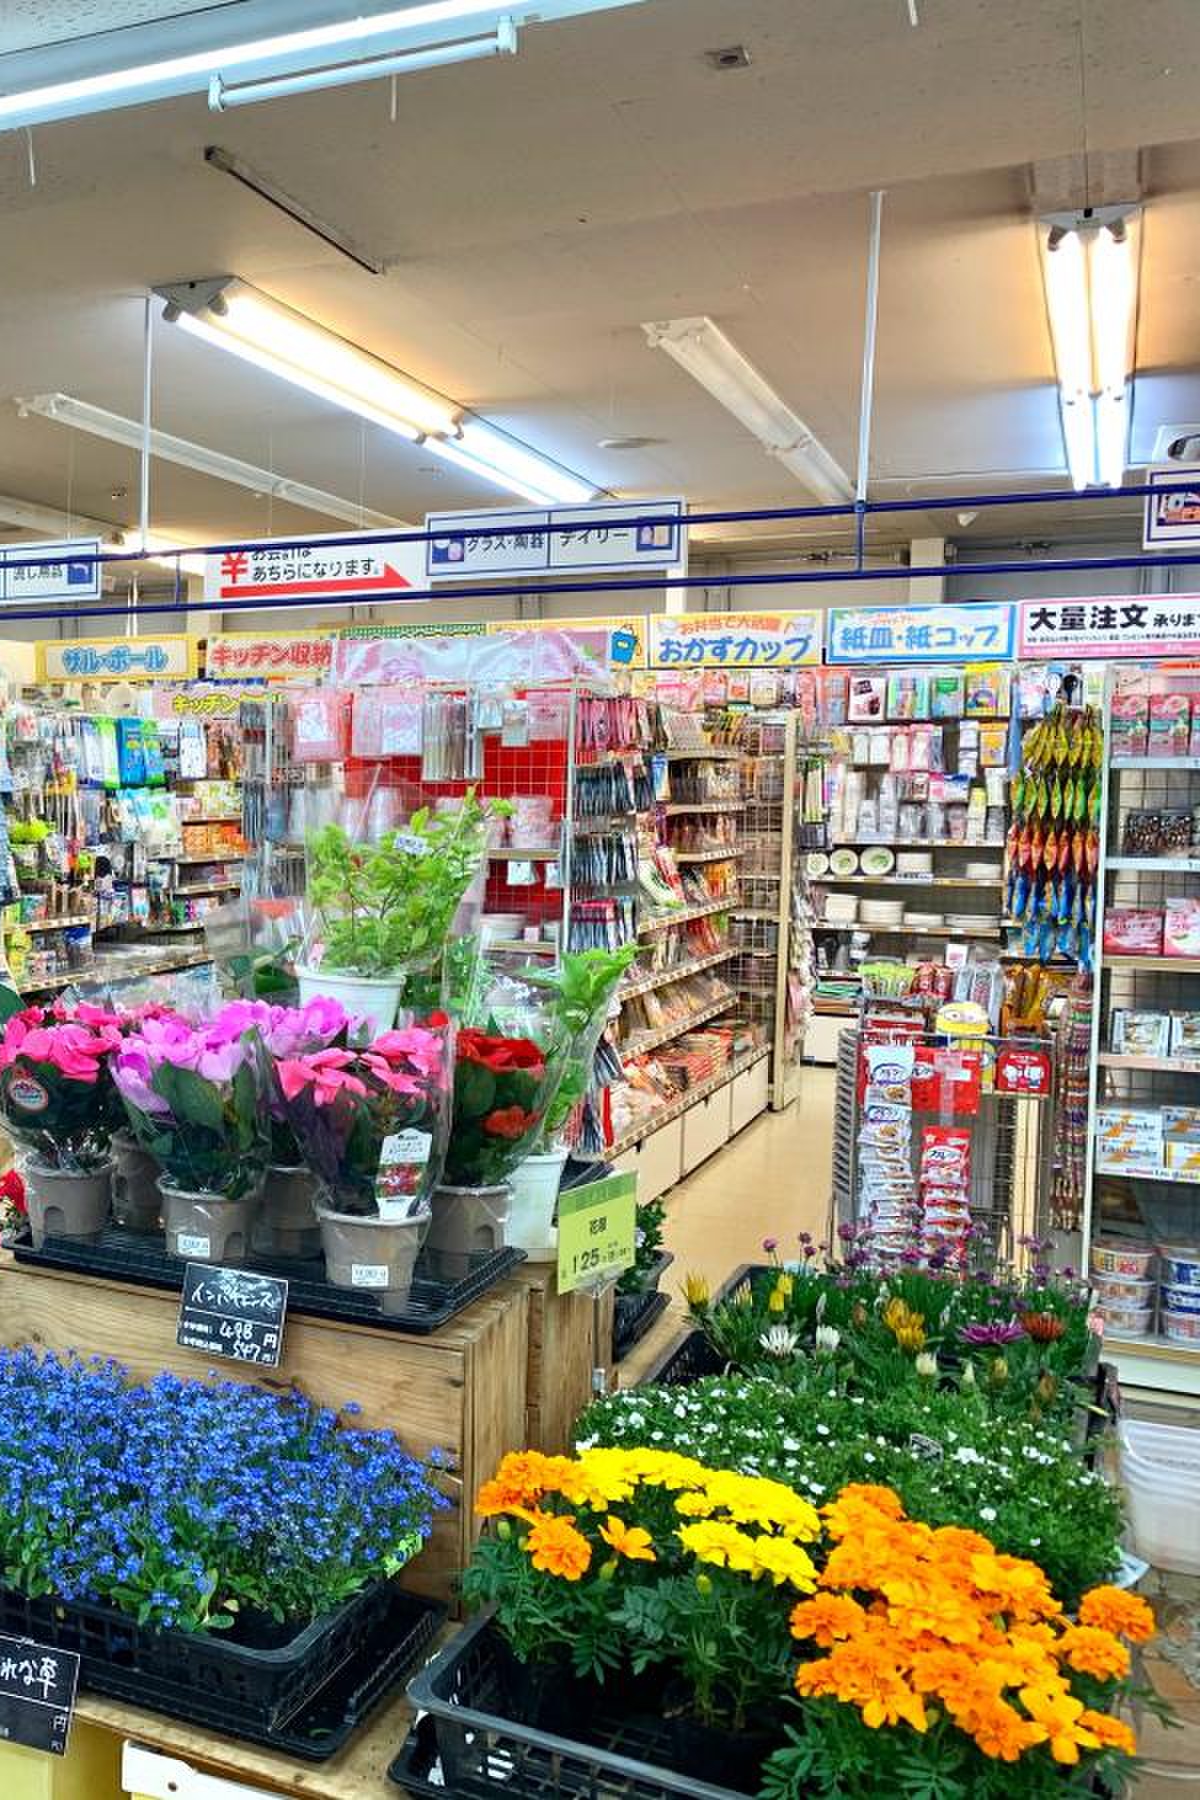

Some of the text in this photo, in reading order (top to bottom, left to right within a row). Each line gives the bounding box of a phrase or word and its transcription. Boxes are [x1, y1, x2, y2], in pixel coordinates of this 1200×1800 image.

[1029, 604, 1200, 632] 大量注文 承りま
[658, 634, 814, 663] おかずカップ
[840, 625, 1000, 651] 紙皿・紙コップ
[210, 641, 333, 669] キッチン収納
[220, 1320, 254, 1340] 498
